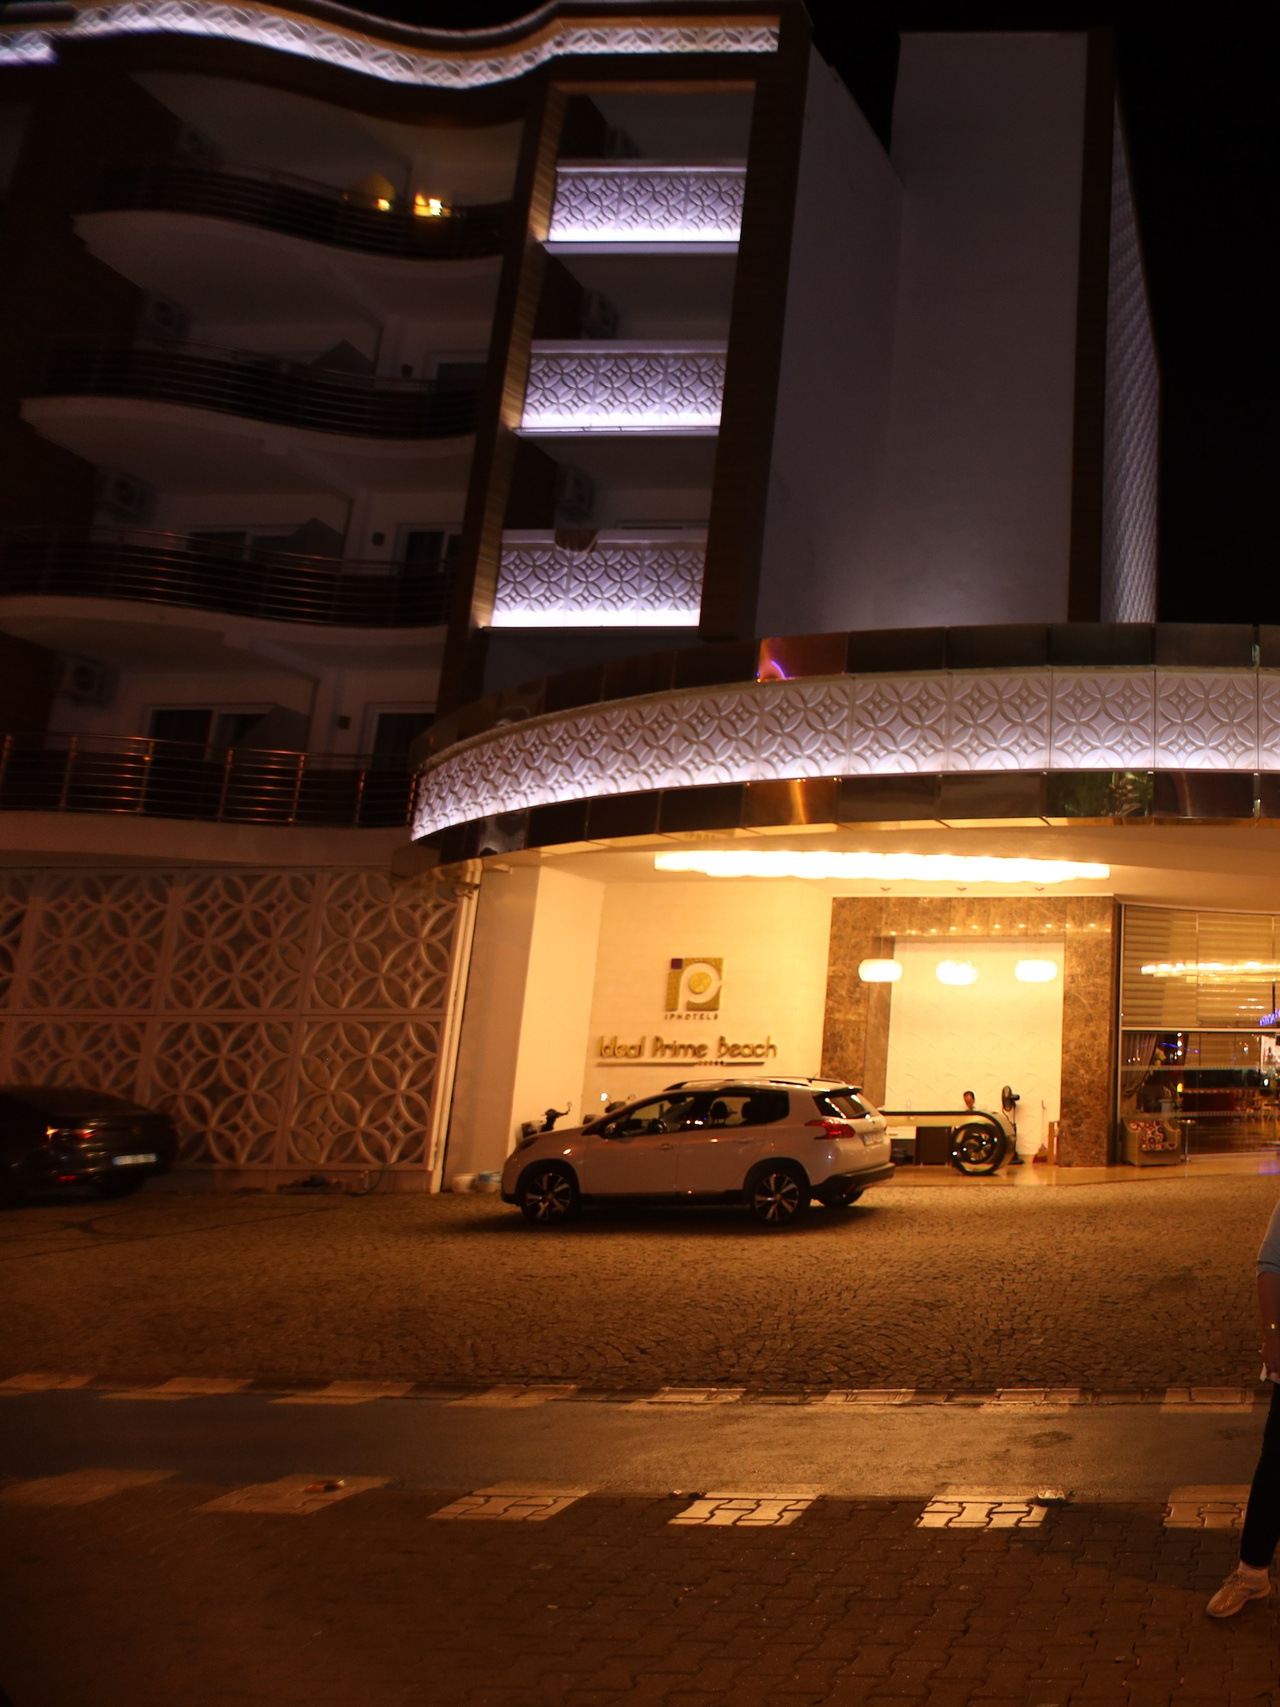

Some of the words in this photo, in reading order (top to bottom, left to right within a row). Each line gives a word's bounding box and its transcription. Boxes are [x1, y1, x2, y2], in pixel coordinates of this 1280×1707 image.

[598, 1036, 646, 1059] Ideal
[651, 1036, 708, 1059] Prime
[717, 1036, 778, 1059] Beach
